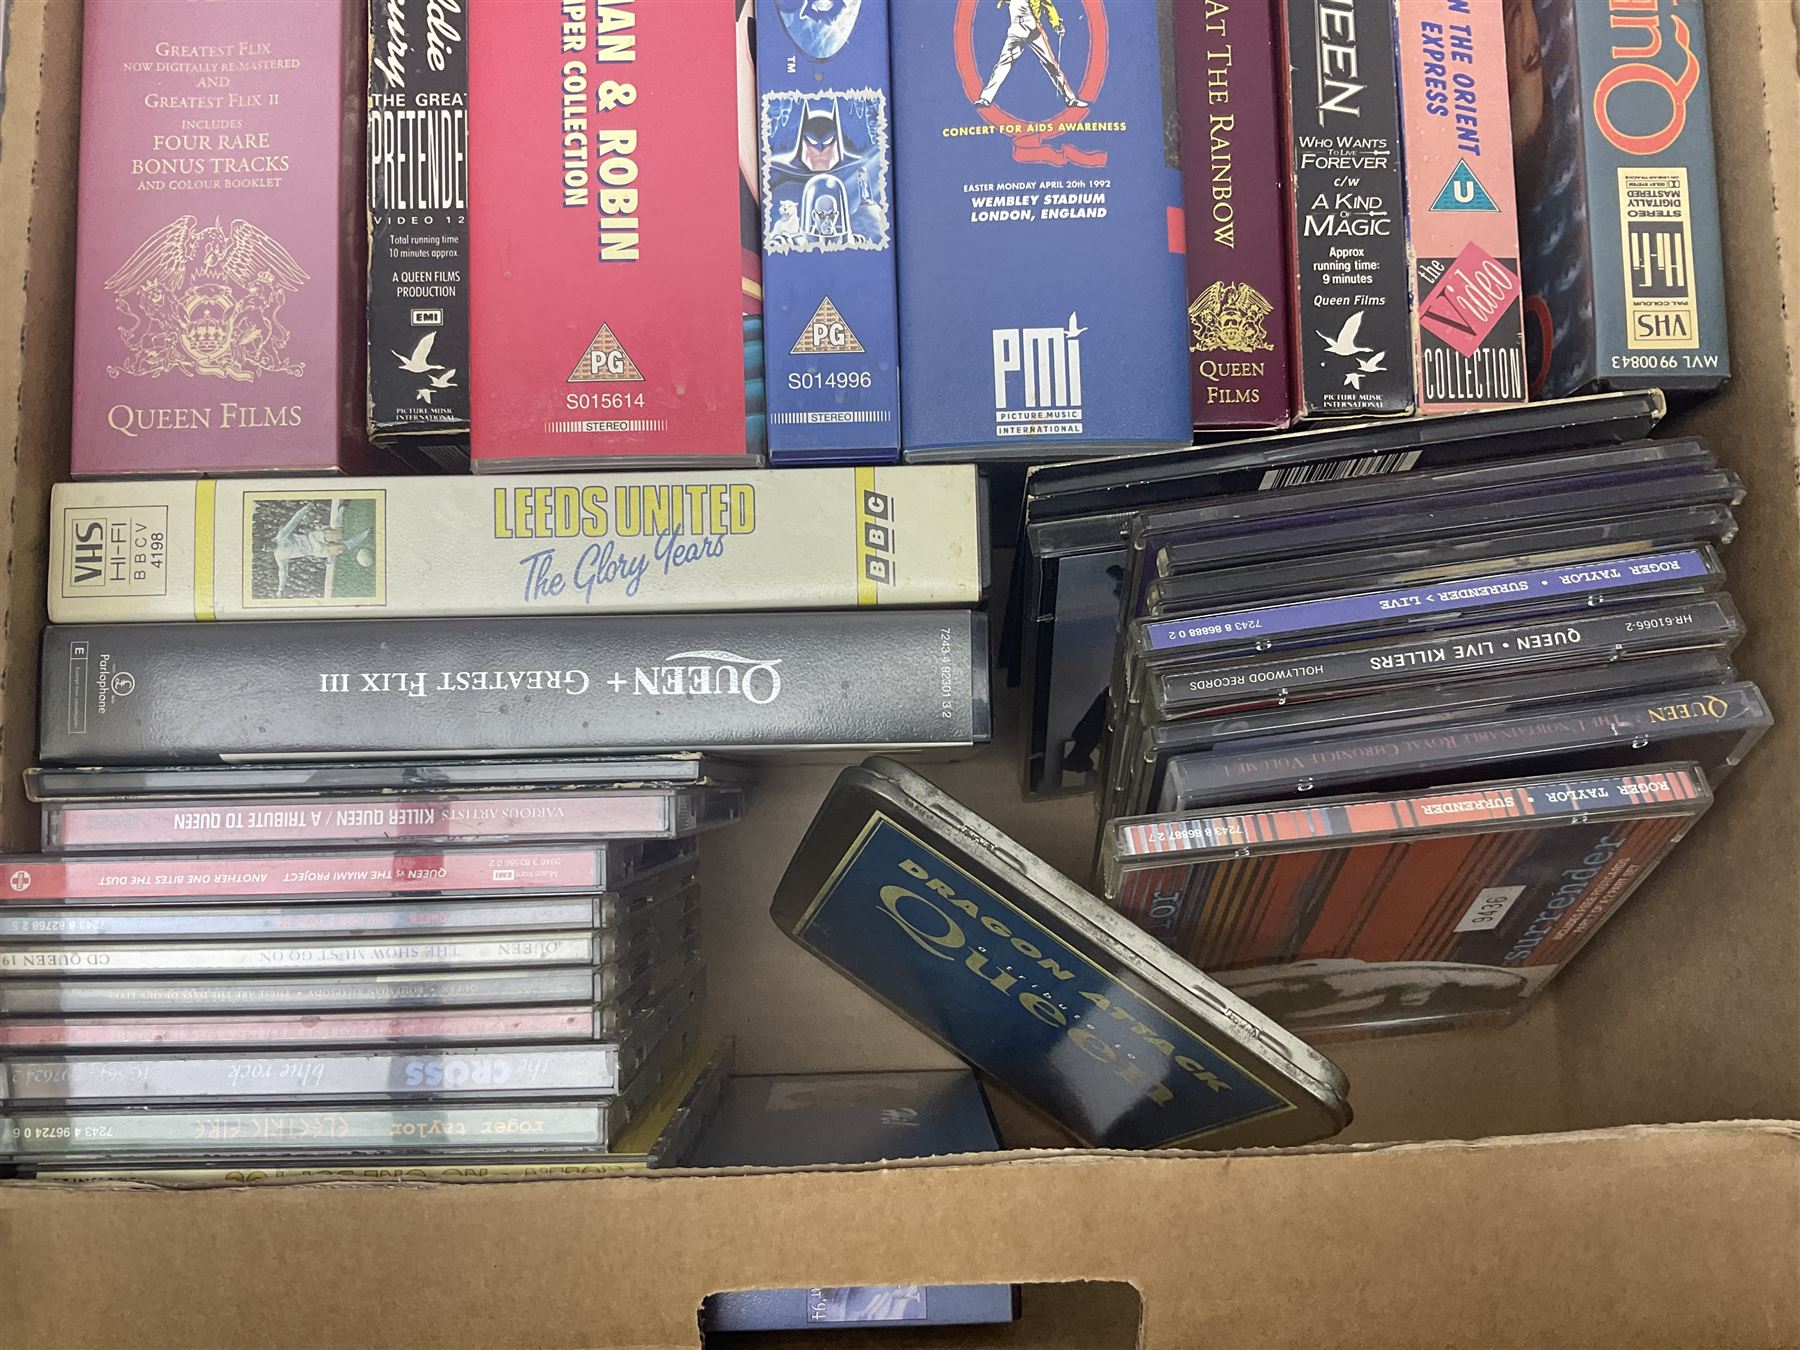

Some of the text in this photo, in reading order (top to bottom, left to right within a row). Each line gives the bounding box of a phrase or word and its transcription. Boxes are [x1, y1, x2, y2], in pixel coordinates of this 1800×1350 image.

[155, 41, 272, 56] GREATEST FLIX
[123, 58, 301, 73] NOW DIGITALLY RE-MASTERED
[786, 56, 797, 73] TM
[1319, 0, 1366, 118] EEN
[1420, 21, 1449, 118] EXPRESS
[196, 76, 230, 88] AND
[1449, 24, 1481, 157] THE ORIENT
[145, 93, 225, 109] GREATEST
[228, 93, 262, 108] FLIX
[371, 93, 406, 107] THE
[181, 119, 243, 131] INCLUDES
[562, 60, 589, 206] COLLECTION
[596, 0, 640, 261] AN & ROBIN
[942, 121, 1127, 137] CONCERT FOR AIDS AWARENESS
[1204, 0, 1236, 249] AT THE RAINBOW
[153, 133, 270, 151] FOUR RARE
[1299, 136, 1388, 149] WHO WANTS
[131, 156, 289, 175] BONUS TRACKS
[371, 109, 468, 210] PRETENDE
[1300, 153, 1388, 169] FOREVER
[137, 177, 283, 191] AND COLOUR BOOKLET
[963, 178, 1112, 193] EASTER MONDAY APRIL 20th 1992
[1333, 175, 1360, 188] c/w
[1454, 181, 1475, 203] U
[1626, 189, 1681, 198] MASTERED
[971, 193, 1106, 209] WEMBLEY STADIUM
[1310, 194, 1383, 210] A KIND
[1627, 199, 1682, 208] DIGITALLY
[373, 215, 434, 225] VIDEO
[971, 207, 1107, 223] LONDON, ENGLAND
[1627, 209, 1682, 218] STEREO
[1303, 217, 1392, 236] MAGIC
[390, 234, 459, 247] Total running time
[389, 248, 399, 259] 10
[400, 248, 429, 259] minutes
[1328, 247, 1365, 260] Approx
[1312, 260, 1381, 273] running time:
[1417, 259, 1446, 284] the
[392, 270, 461, 284] A QUEEN FILMS
[1322, 274, 1373, 285] 9 minutes
[396, 286, 456, 298] PRODUCTION
[1313, 294, 1386, 307] Queen Films
[1419, 259, 1514, 337] Video
[415, 313, 438, 323] EMI
[1637, 315, 1688, 338] VHS
[813, 323, 846, 346] PG
[591, 350, 625, 375] PG
[1199, 361, 1266, 379] QUEEN
[1611, 354, 1719, 369] MVL 99 00843
[787, 371, 872, 389] S014996
[1423, 347, 1523, 400] COLLECTION
[566, 392, 645, 410] S015614
[1207, 386, 1261, 403] FILMS
[396, 407, 427, 415] PICTURE
[810, 412, 852, 422] STEREO
[1001, 410, 1078, 421] PICTURE MUSIC
[108, 404, 302, 436] QUEEN FILMS
[585, 421, 629, 431] STEREO
[998, 424, 1081, 435] INTERNATIONAL
[493, 482, 757, 540] LEEDS UNITED
[865, 491, 889, 584] BBC
[73, 521, 104, 584] VHS
[109, 521, 128, 582] HI-FI
[151, 531, 165, 569] 4198
[519, 523, 726, 605] The Glory Years
[1379, 559, 1682, 611] ROGER TAYLOR SURRENDER LIVE
[1189, 621, 1263, 639] 7243 86888
[941, 627, 951, 653] 7243
[1370, 628, 1582, 671] QUEEN LIVE KILLERS
[97, 653, 111, 714] Parlophone
[320, 650, 783, 705] QUEEN GREATEST FLIX III
[1188, 664, 1325, 692] HOLLYWOOD RECORDS
[1648, 695, 1729, 723] QUEEN
[1420, 780, 1671, 815] ROGER TAYLOR SURRENDER
[174, 807, 565, 831] VARIOUS ARTISTS KILLER QUEEN A TRIBUTE TO QUEEN
[1214, 825, 1243, 836] 7243
[98, 873, 268, 886] ANOTHER ONE BITES THE DUST
[282, 867, 447, 883] QUEEN THE MIAMI PROJECT
[1504, 835, 1628, 962] surrender
[1472, 896, 1508, 924] 9436
[259, 951, 285, 963] ON
[289, 950, 313, 963] GO
[316, 948, 364, 962] MUST
[370, 946, 420, 960] SHOW
[498, 941, 560, 957] QUEEN
[2, 953, 111, 967] CD QUEEN 19
[897, 858, 1233, 1093] DRAGON ATTACK
[228, 1063, 326, 1087] blue rock
[404, 1058, 512, 1087] CROSS
[34, 1126, 114, 1138] 7243 96724
[390, 1120, 545, 1138] roger taylor
